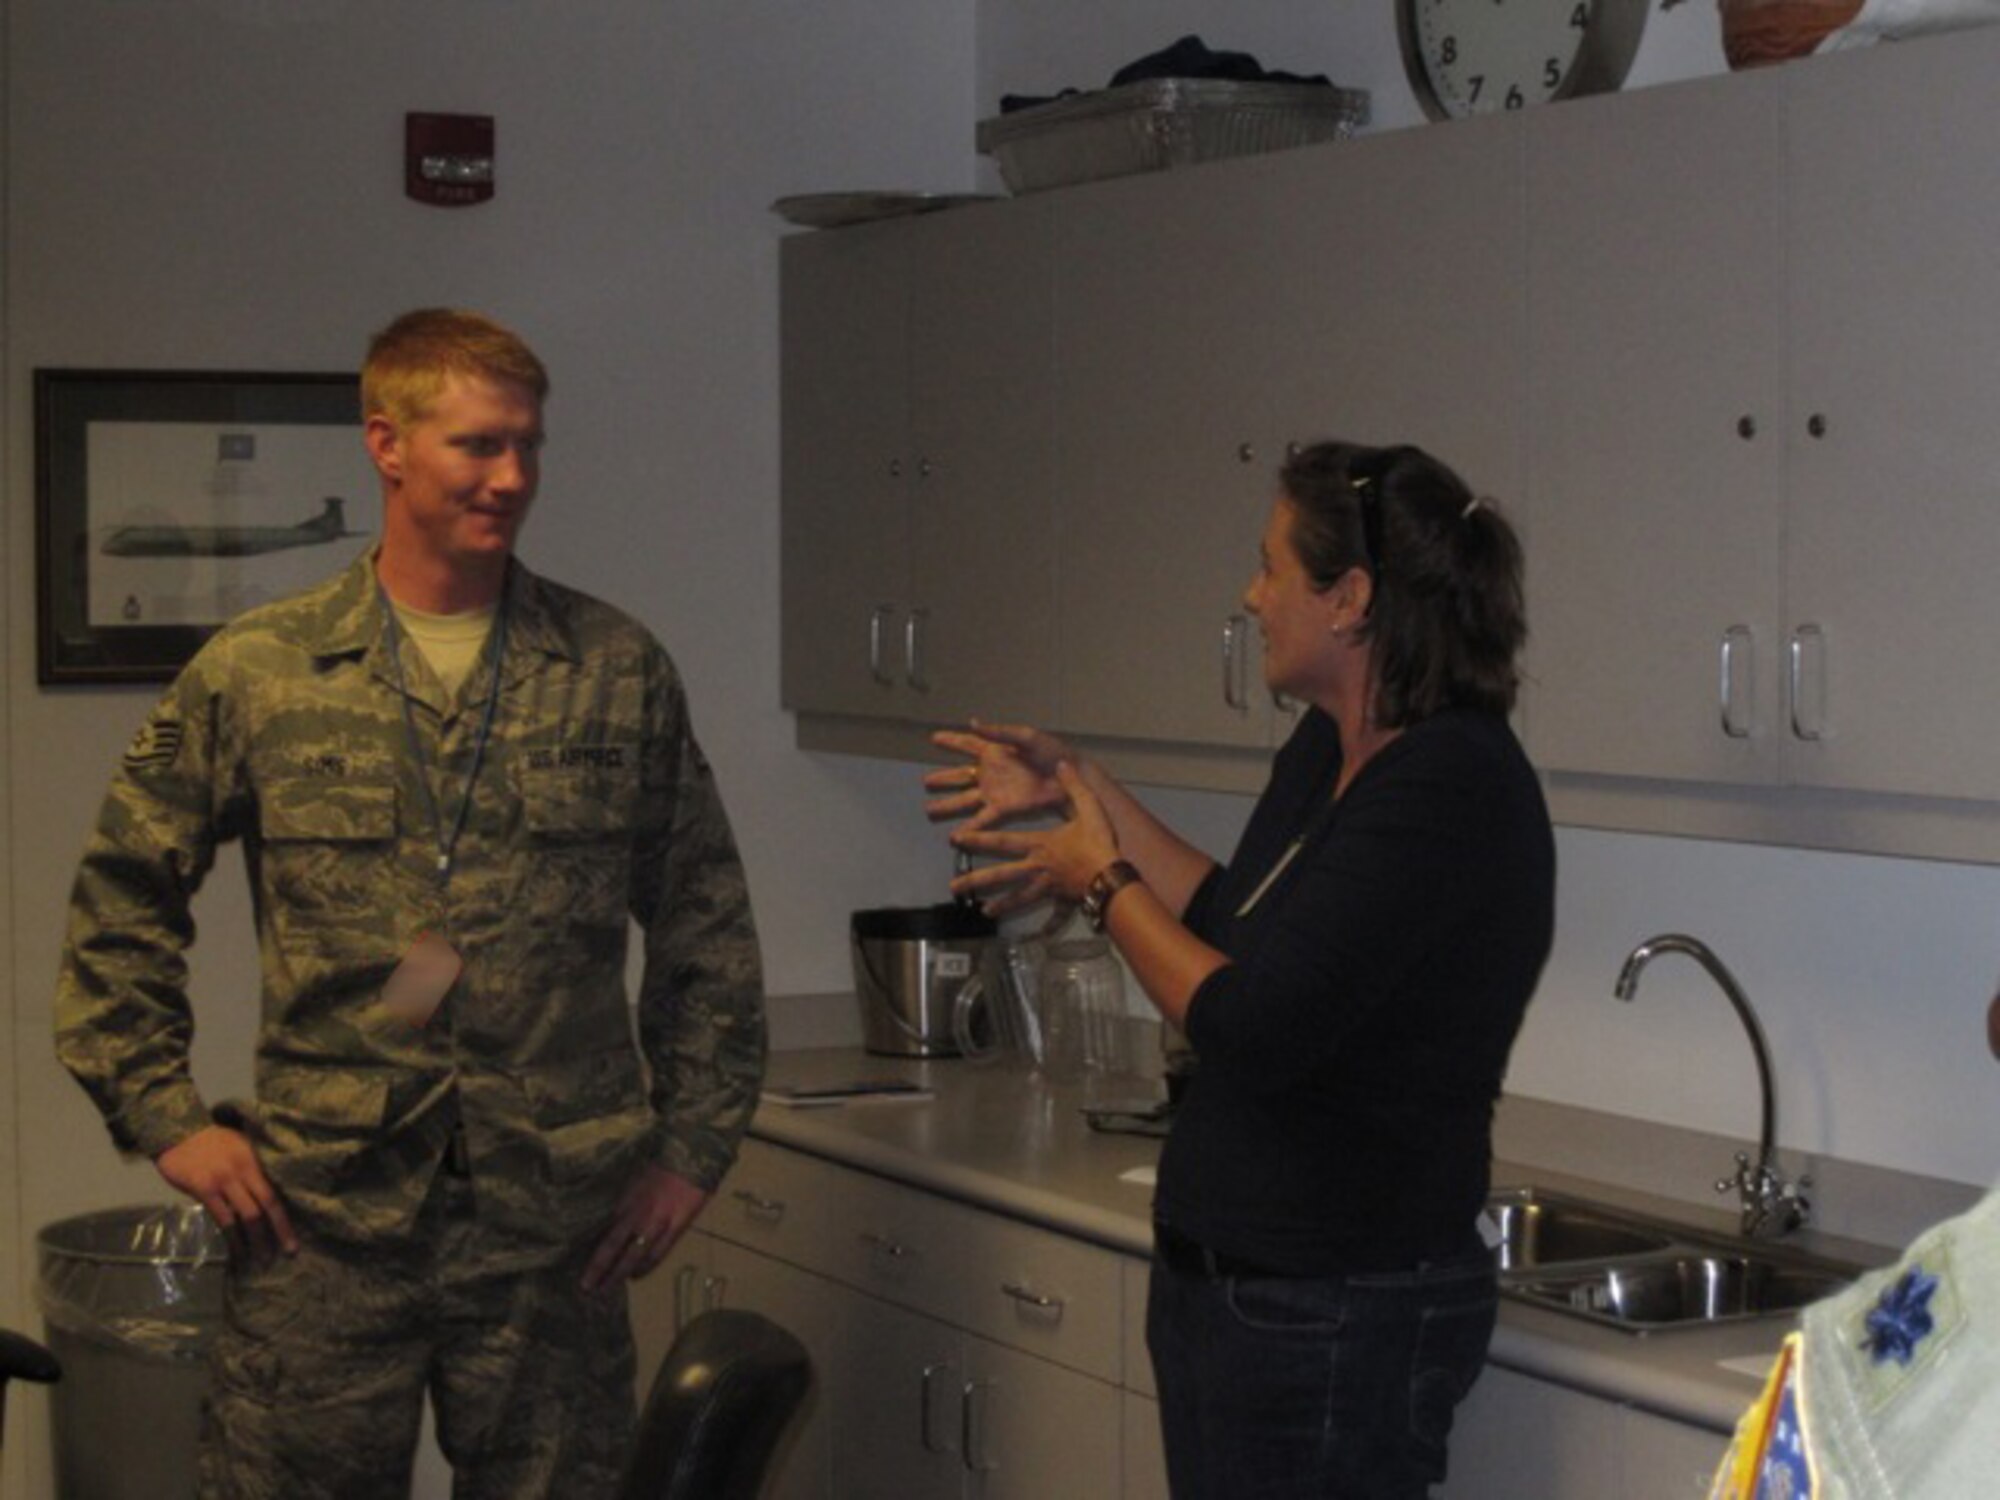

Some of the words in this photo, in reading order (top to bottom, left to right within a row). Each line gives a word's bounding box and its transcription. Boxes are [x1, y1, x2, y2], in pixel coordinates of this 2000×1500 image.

[1570, 2, 1589, 29] 4
[1441, 37, 1457, 64] 8
[1544, 58, 1561, 88] 5
[1468, 76, 1485, 104] 7
[1505, 84, 1524, 110] 6
